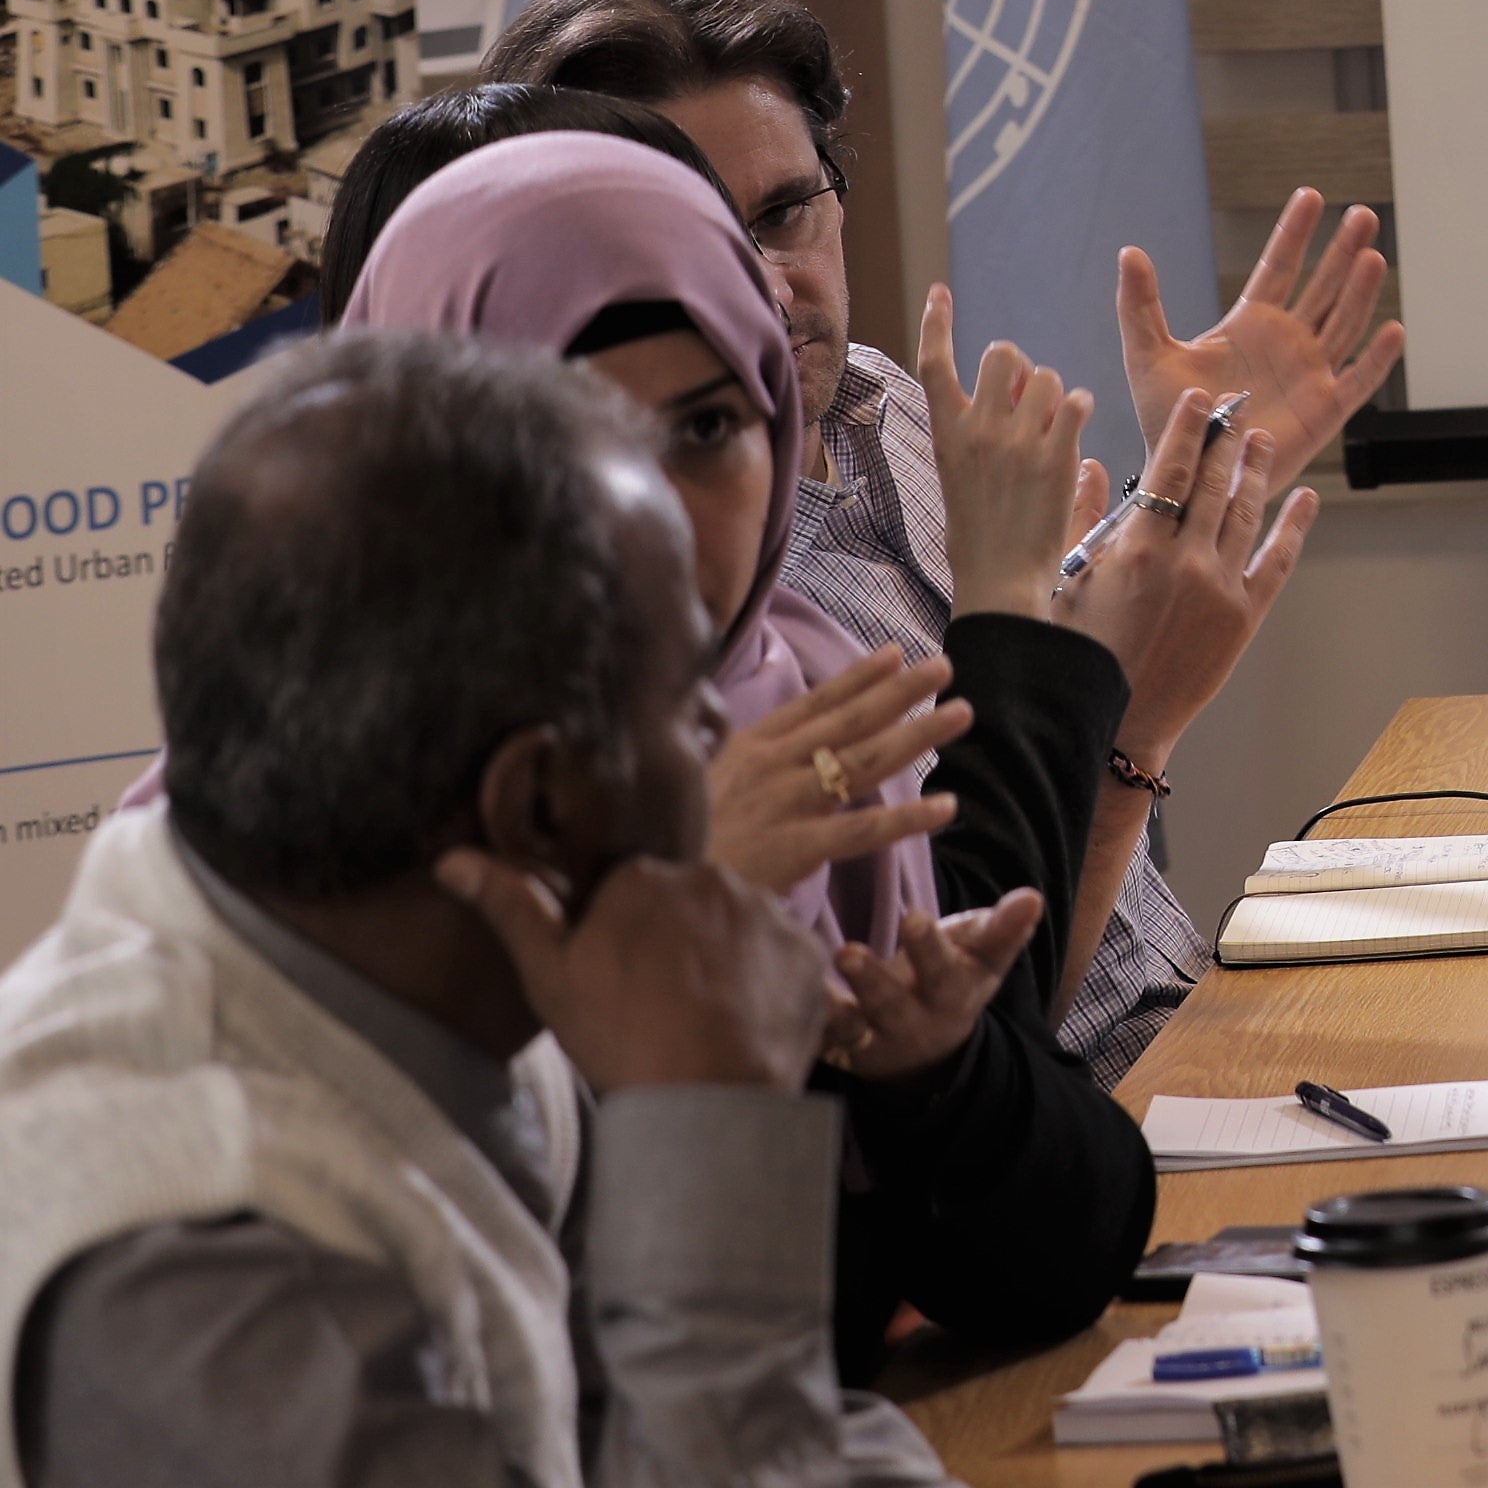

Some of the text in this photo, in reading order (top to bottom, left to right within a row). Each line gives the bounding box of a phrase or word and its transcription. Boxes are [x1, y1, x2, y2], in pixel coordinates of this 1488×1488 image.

[2, 485, 122, 542] OOD
[53, 549, 154, 584] Urban
[15, 802, 99, 842] mixed
